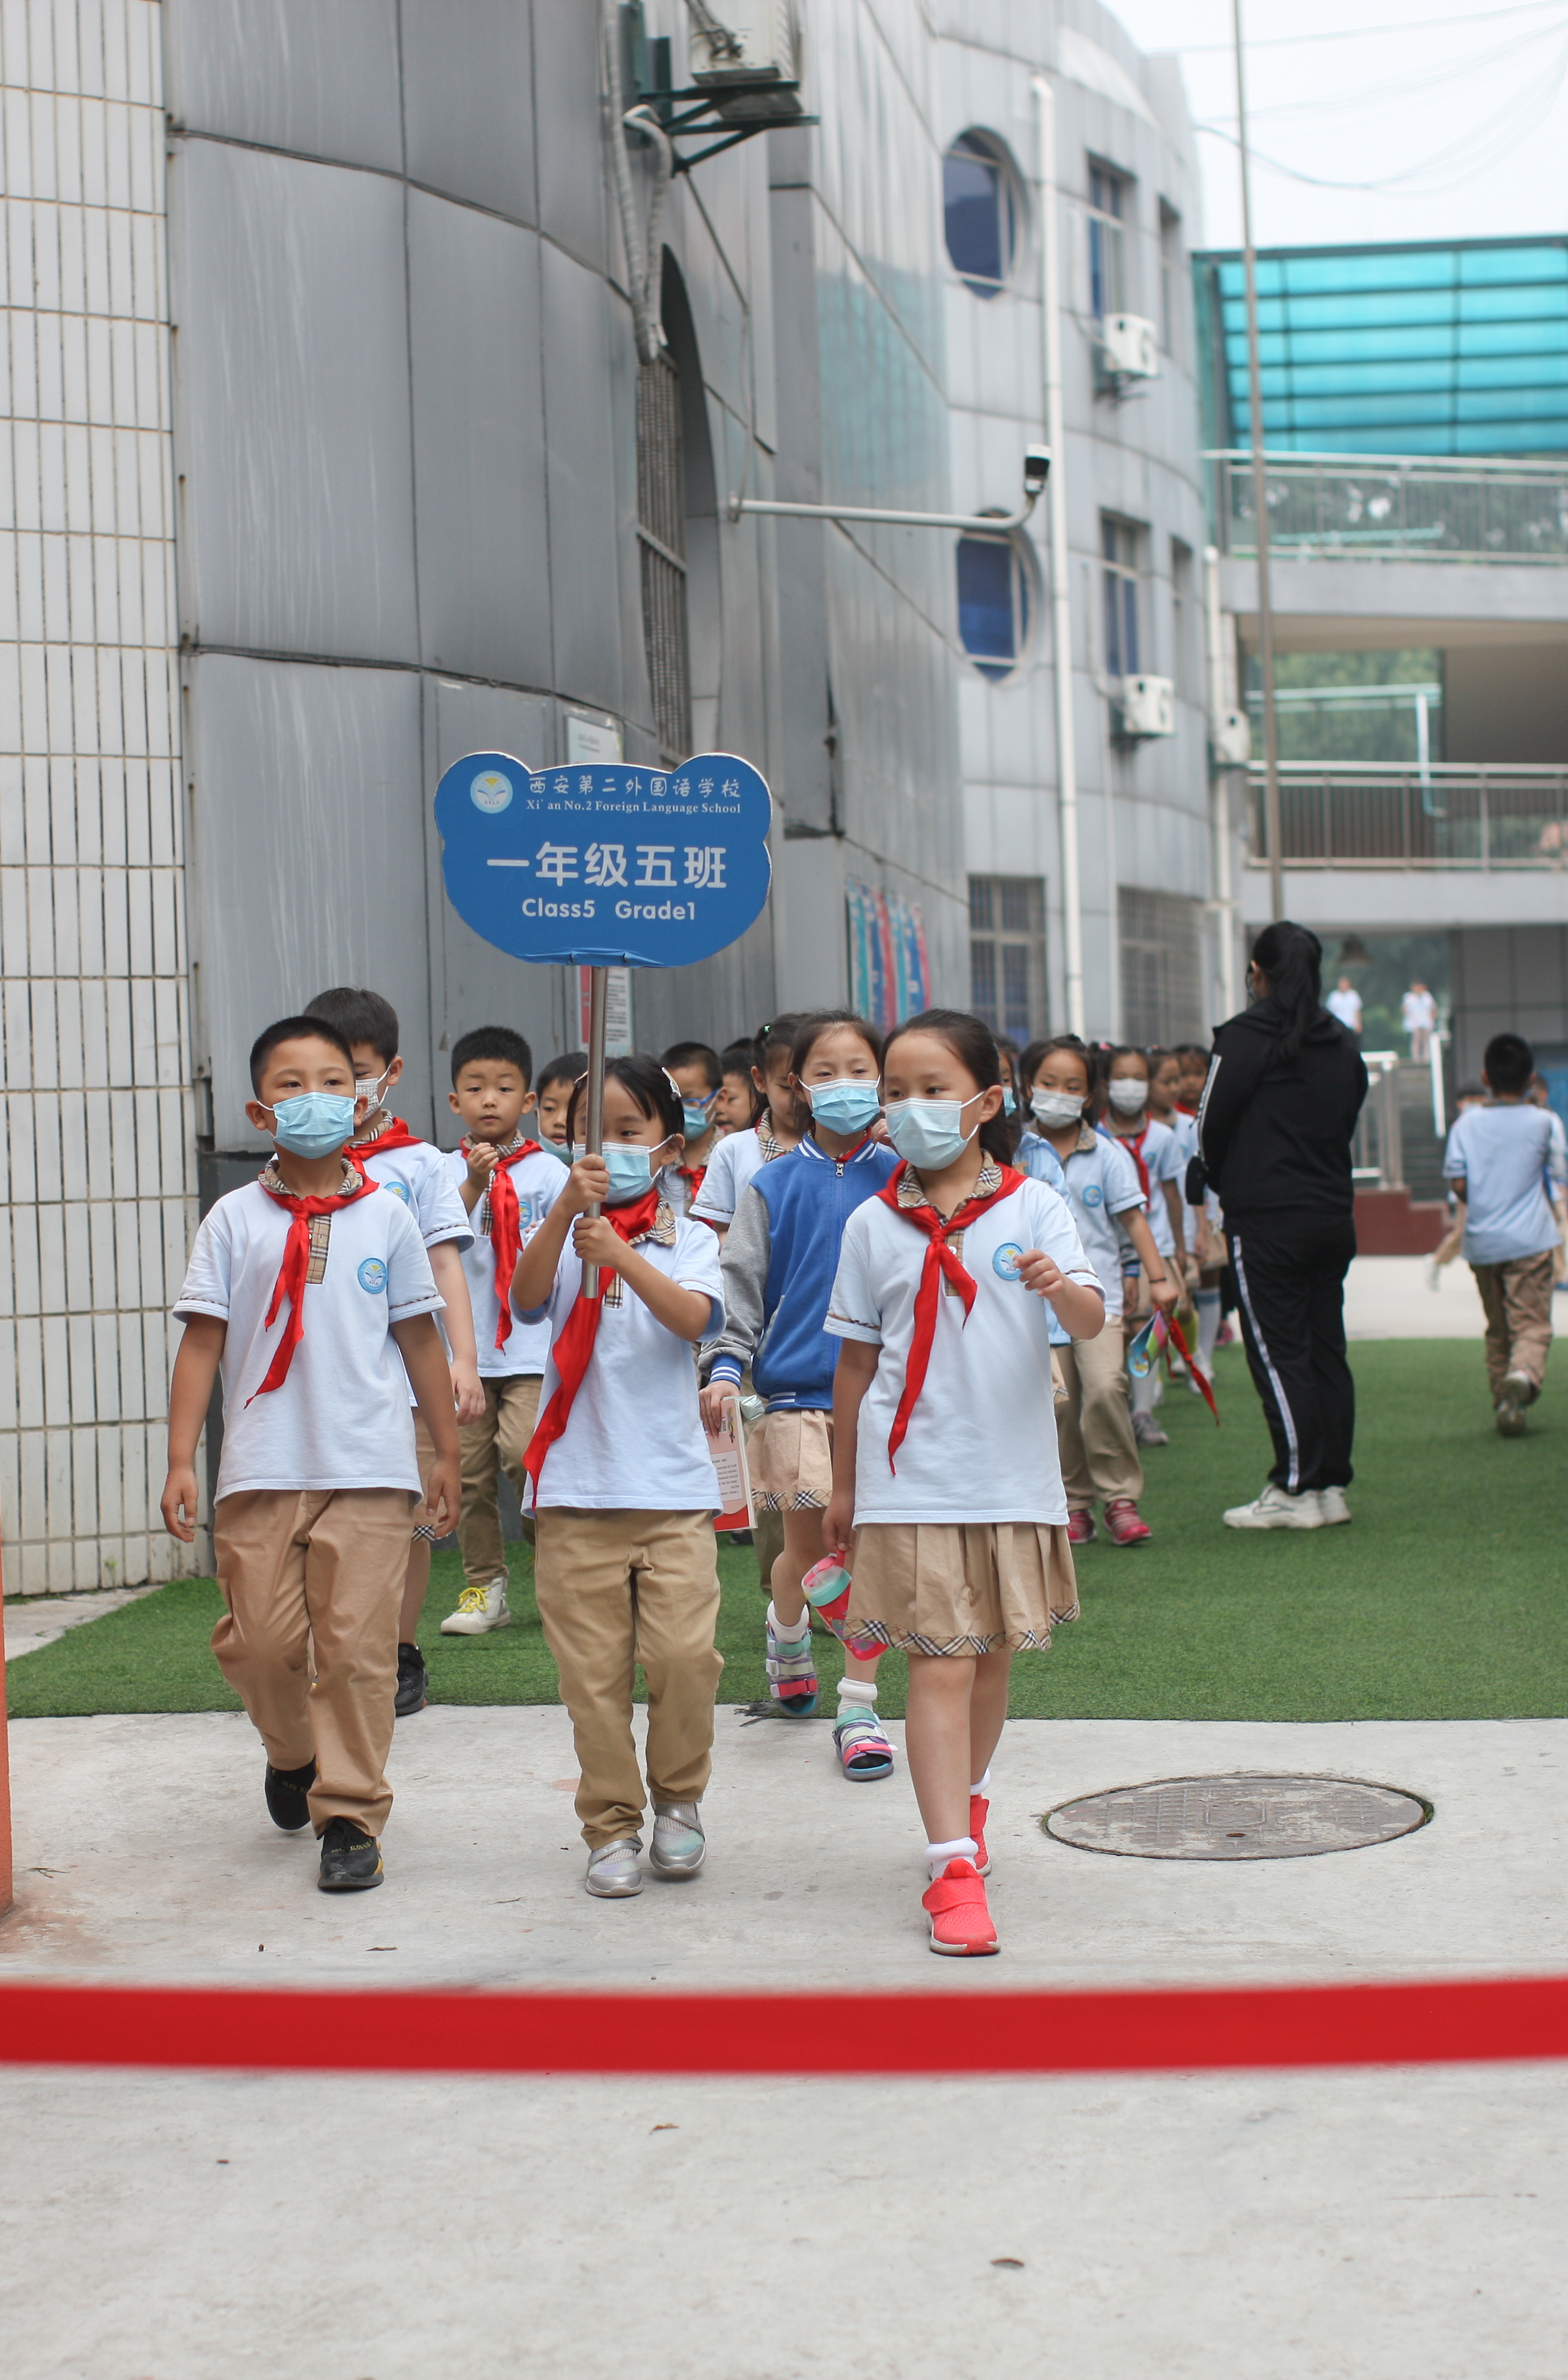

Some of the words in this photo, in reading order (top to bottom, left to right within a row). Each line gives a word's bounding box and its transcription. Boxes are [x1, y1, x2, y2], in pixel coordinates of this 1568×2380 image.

[529, 774, 741, 798] 西安第二外国语学校
[564, 800, 592, 810] No.2
[595, 800, 639, 814] Foreign
[643, 802, 699, 815] Language
[701, 802, 741, 814] School
[486, 841, 727, 889] 一年级五班
[522, 898, 596, 919] Class5
[615, 900, 695, 920] Grade1
